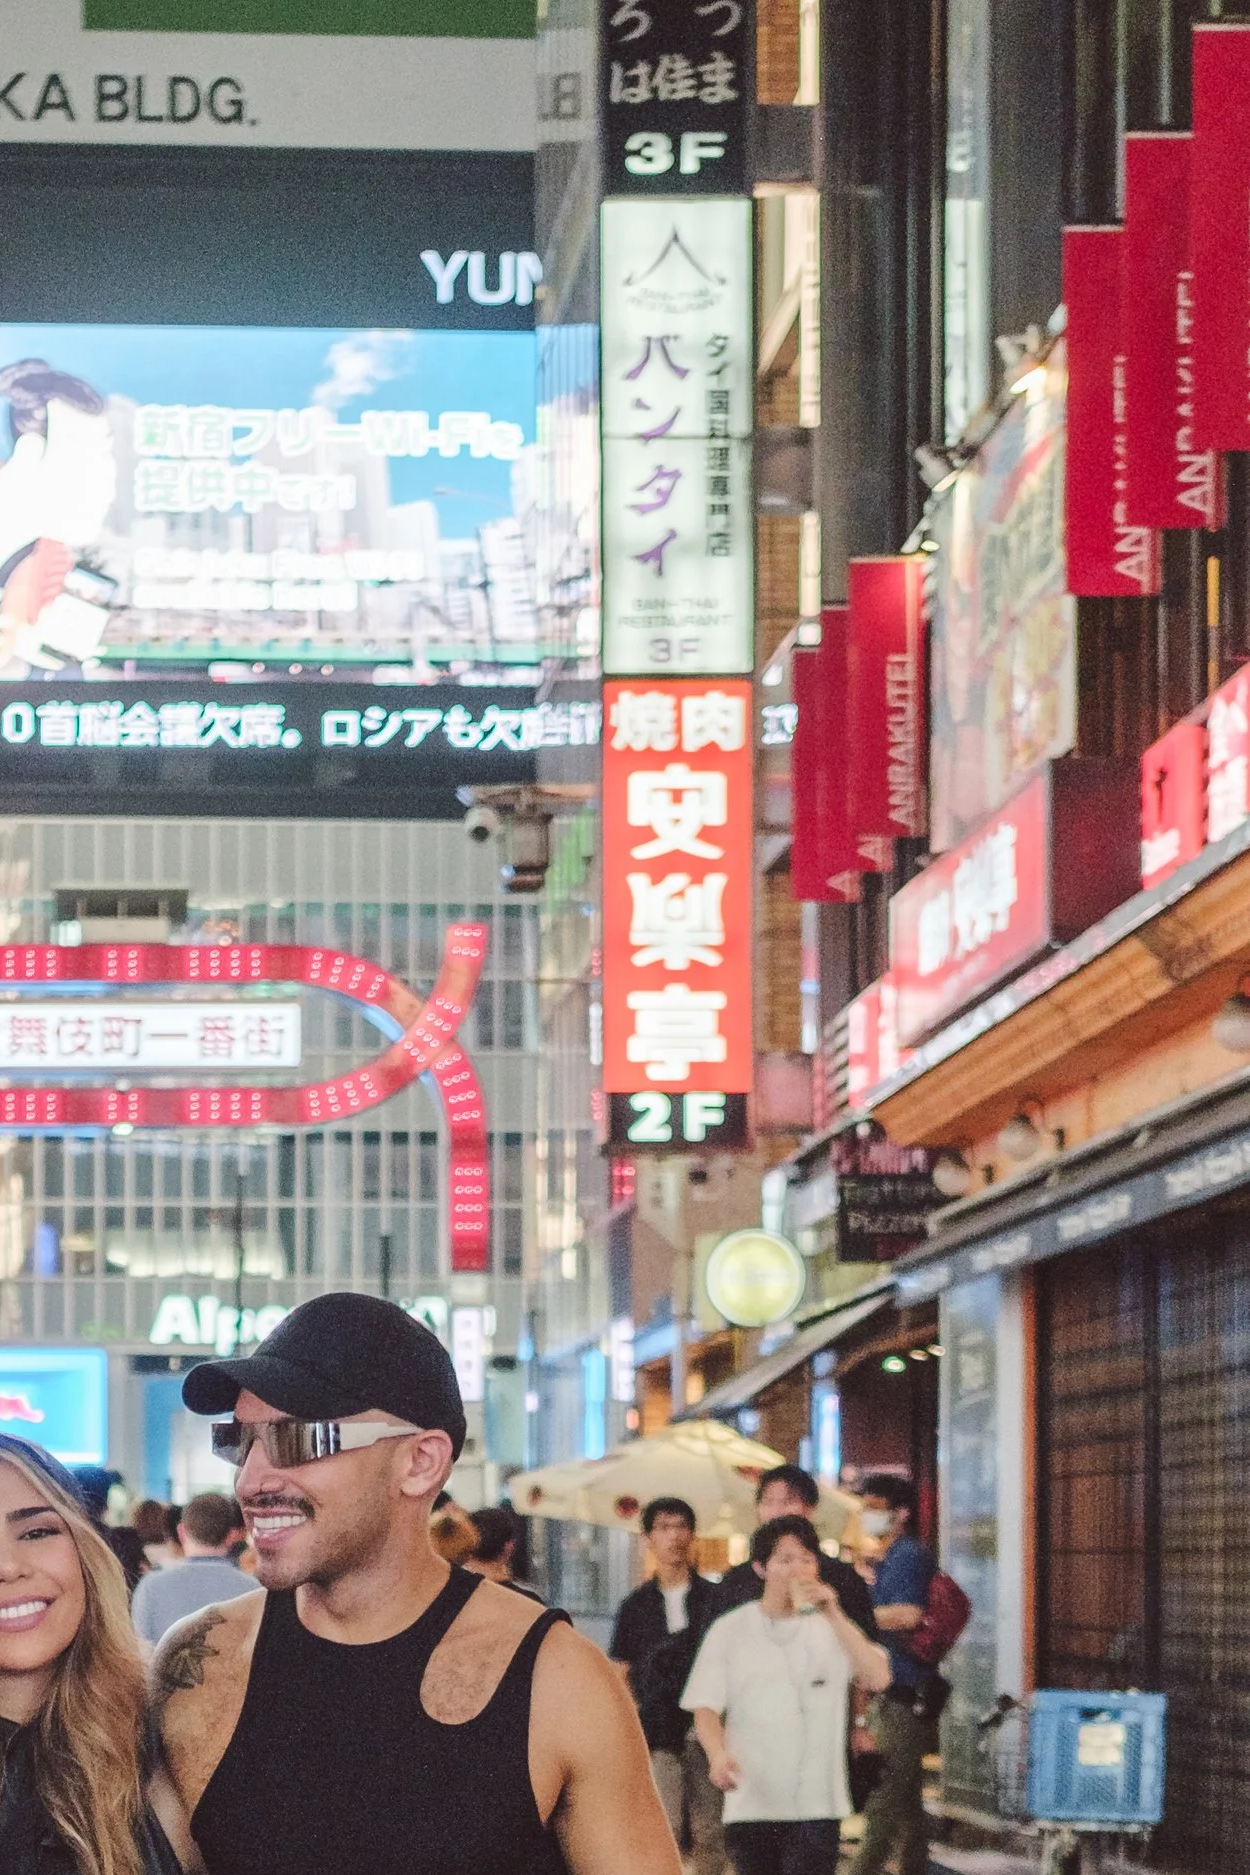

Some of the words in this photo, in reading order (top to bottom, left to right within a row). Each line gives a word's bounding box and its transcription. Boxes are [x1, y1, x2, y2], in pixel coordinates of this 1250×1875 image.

[95, 72, 257, 126] BLDG.
[625, 131, 729, 175] 3F
[622, 335, 690, 578] バンタイ
[648, 637, 701, 663] 3F
[610, 691, 746, 752] 焼肉
[628, 1091, 726, 1143] 2F
